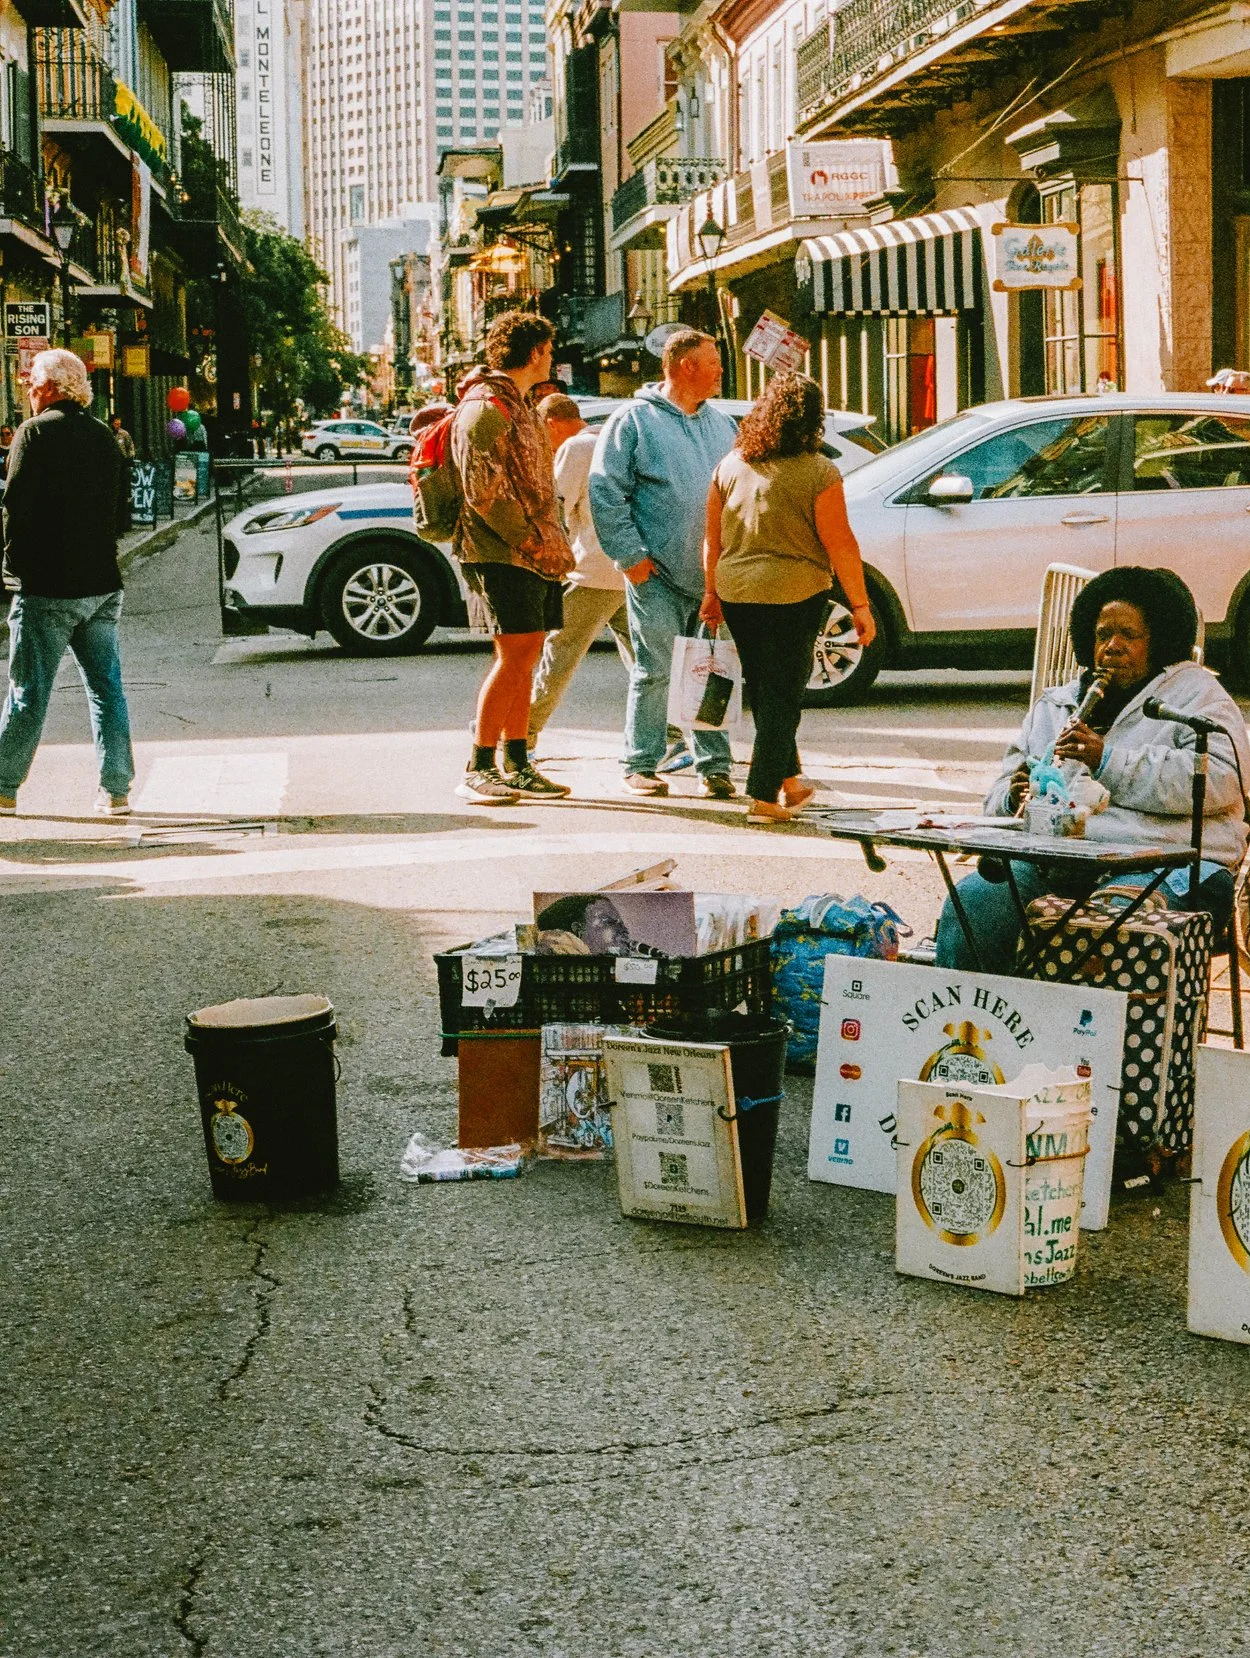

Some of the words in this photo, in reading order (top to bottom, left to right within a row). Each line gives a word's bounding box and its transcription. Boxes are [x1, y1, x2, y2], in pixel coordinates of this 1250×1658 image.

[256, 27, 271, 182] MONTELEONE
[18, 305, 35, 313] THE
[7, 314, 47, 324] RISING
[14, 325, 40, 335] SON
[842, 990, 871, 1001] Square
[902, 985, 962, 1033] SCAN
[973, 987, 1035, 1050] HERE
[663, 1046, 682, 1057] New
